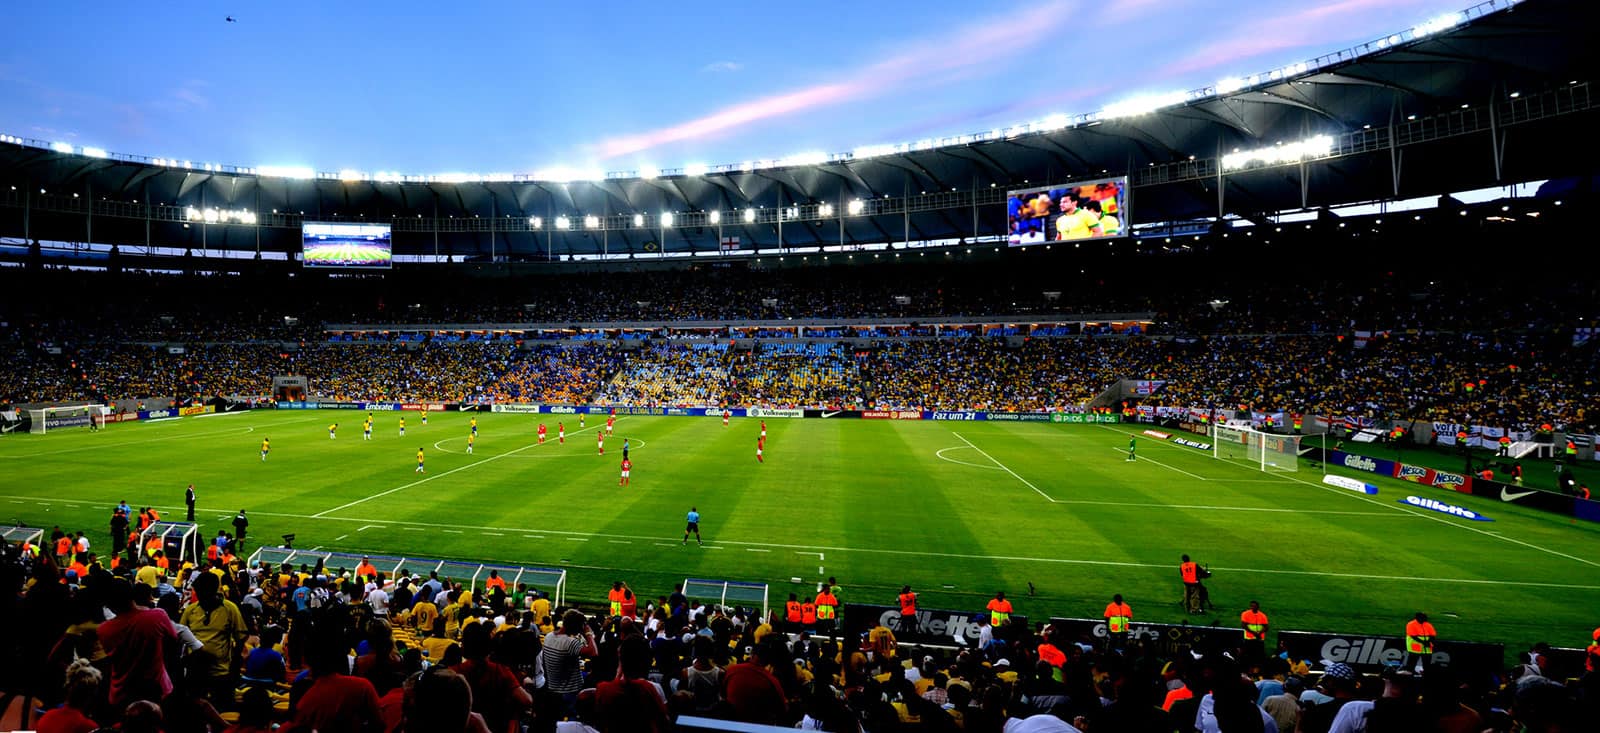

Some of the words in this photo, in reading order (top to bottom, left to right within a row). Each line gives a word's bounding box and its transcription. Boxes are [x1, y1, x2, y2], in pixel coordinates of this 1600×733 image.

[705, 408, 733, 416] Gillee
[932, 411, 947, 420] Faz
[965, 412, 976, 420] 21
[1344, 454, 1376, 471] Gillette
[1407, 496, 1475, 518] Gillette
[880, 609, 981, 638] Gllette
[1093, 624, 1159, 640] Gette
[1321, 638, 1450, 667] Gillee
